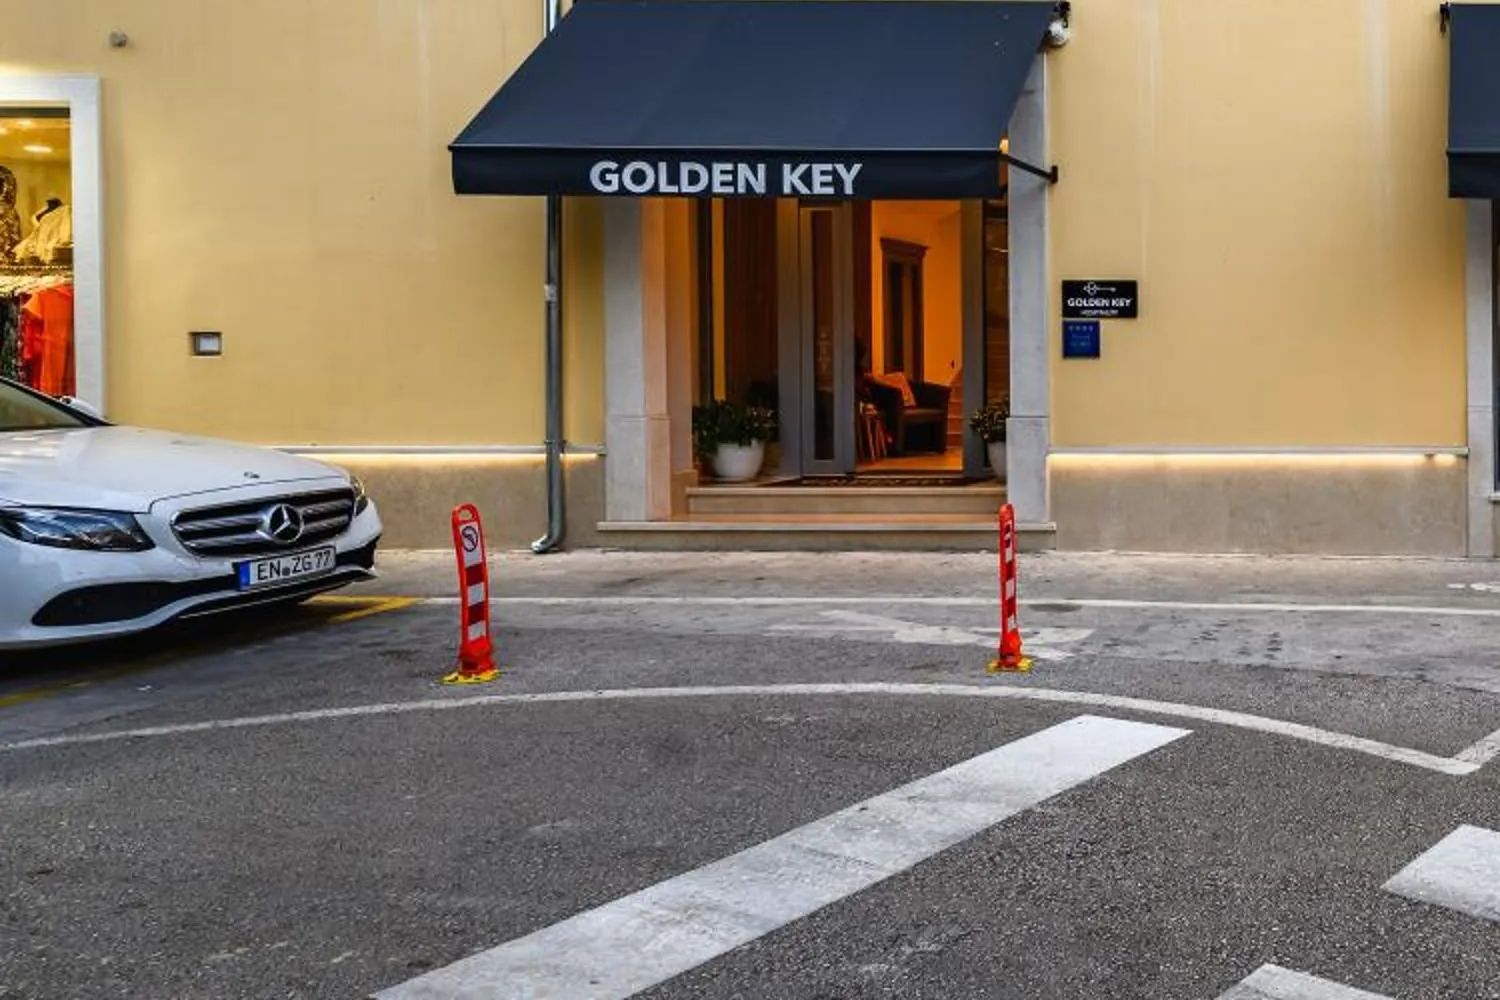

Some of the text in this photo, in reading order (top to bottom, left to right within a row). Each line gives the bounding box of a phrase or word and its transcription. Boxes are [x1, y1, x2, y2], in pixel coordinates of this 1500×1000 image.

[589, 160, 863, 195] GOLDEN KEY
[1067, 297, 1132, 307] GOLDEN KEY
